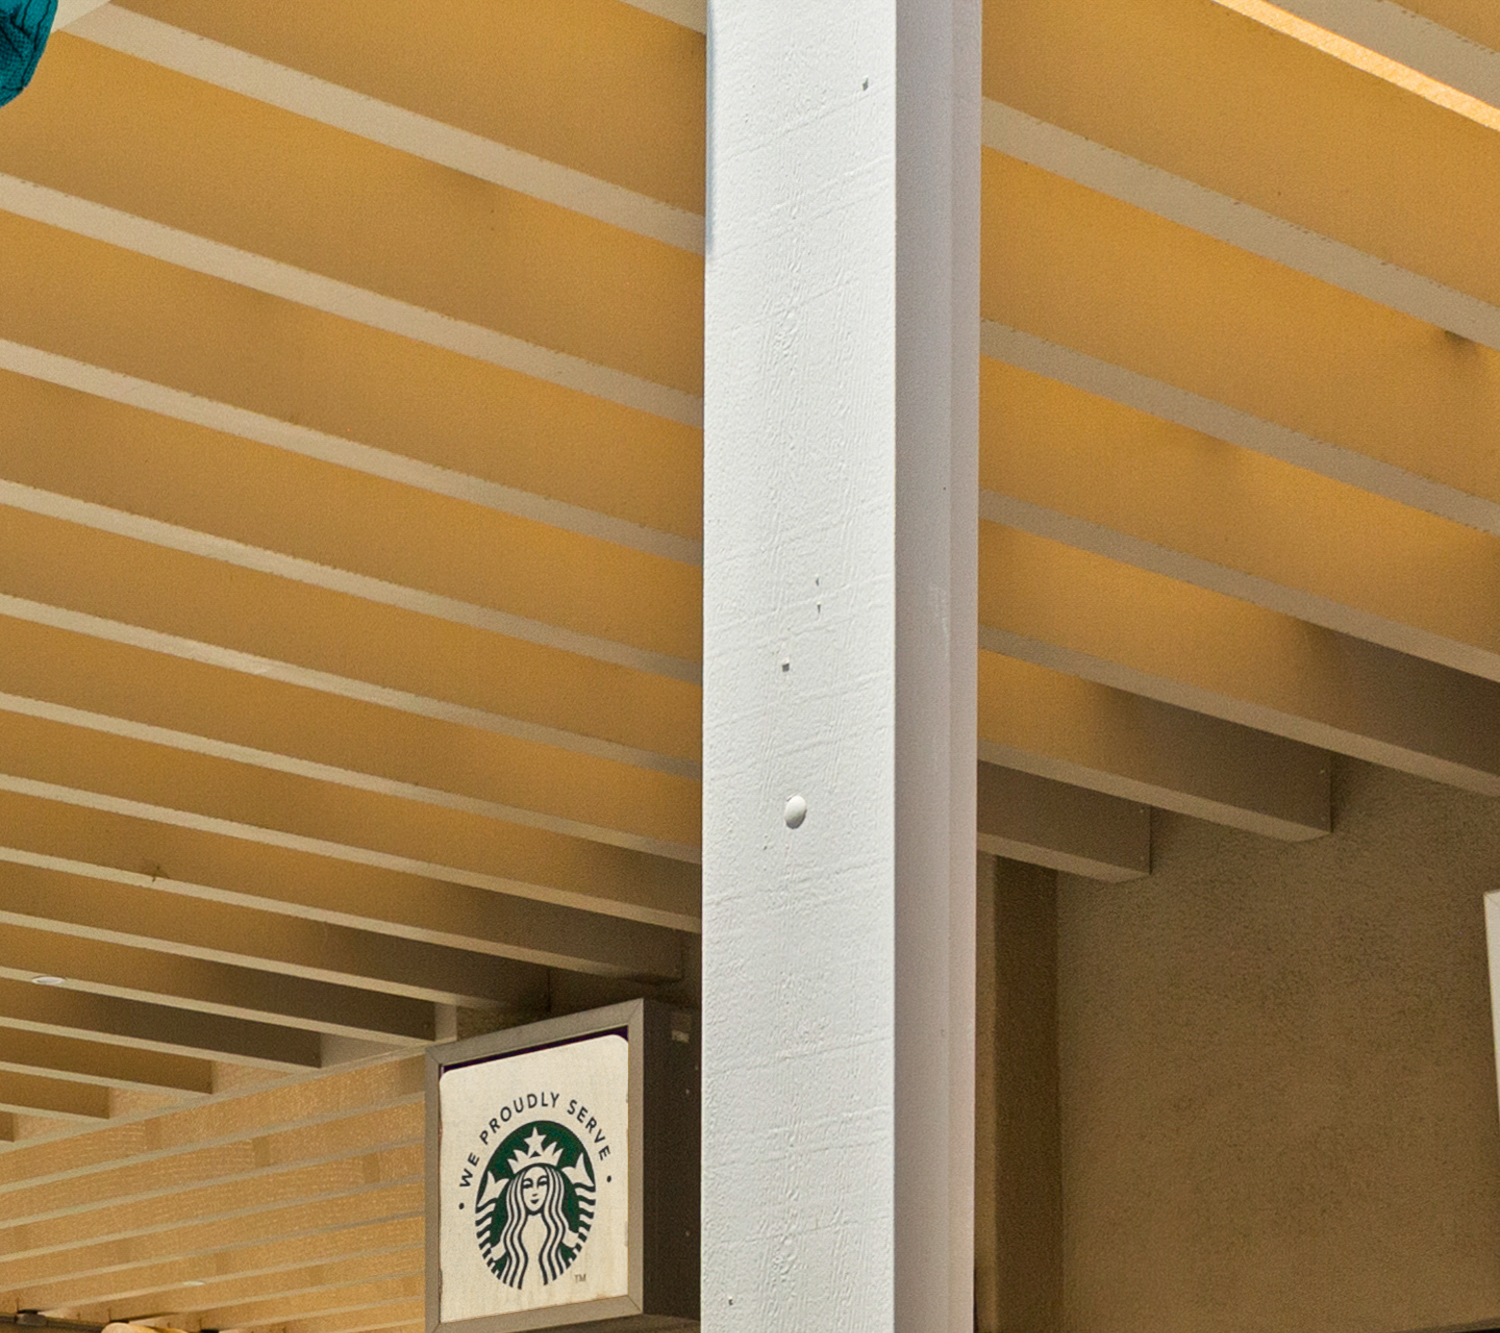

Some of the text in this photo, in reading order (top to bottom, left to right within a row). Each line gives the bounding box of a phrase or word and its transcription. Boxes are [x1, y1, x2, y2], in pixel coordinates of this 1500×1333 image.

[459, 1091, 611, 1189] WE PROUDLY SERVE
